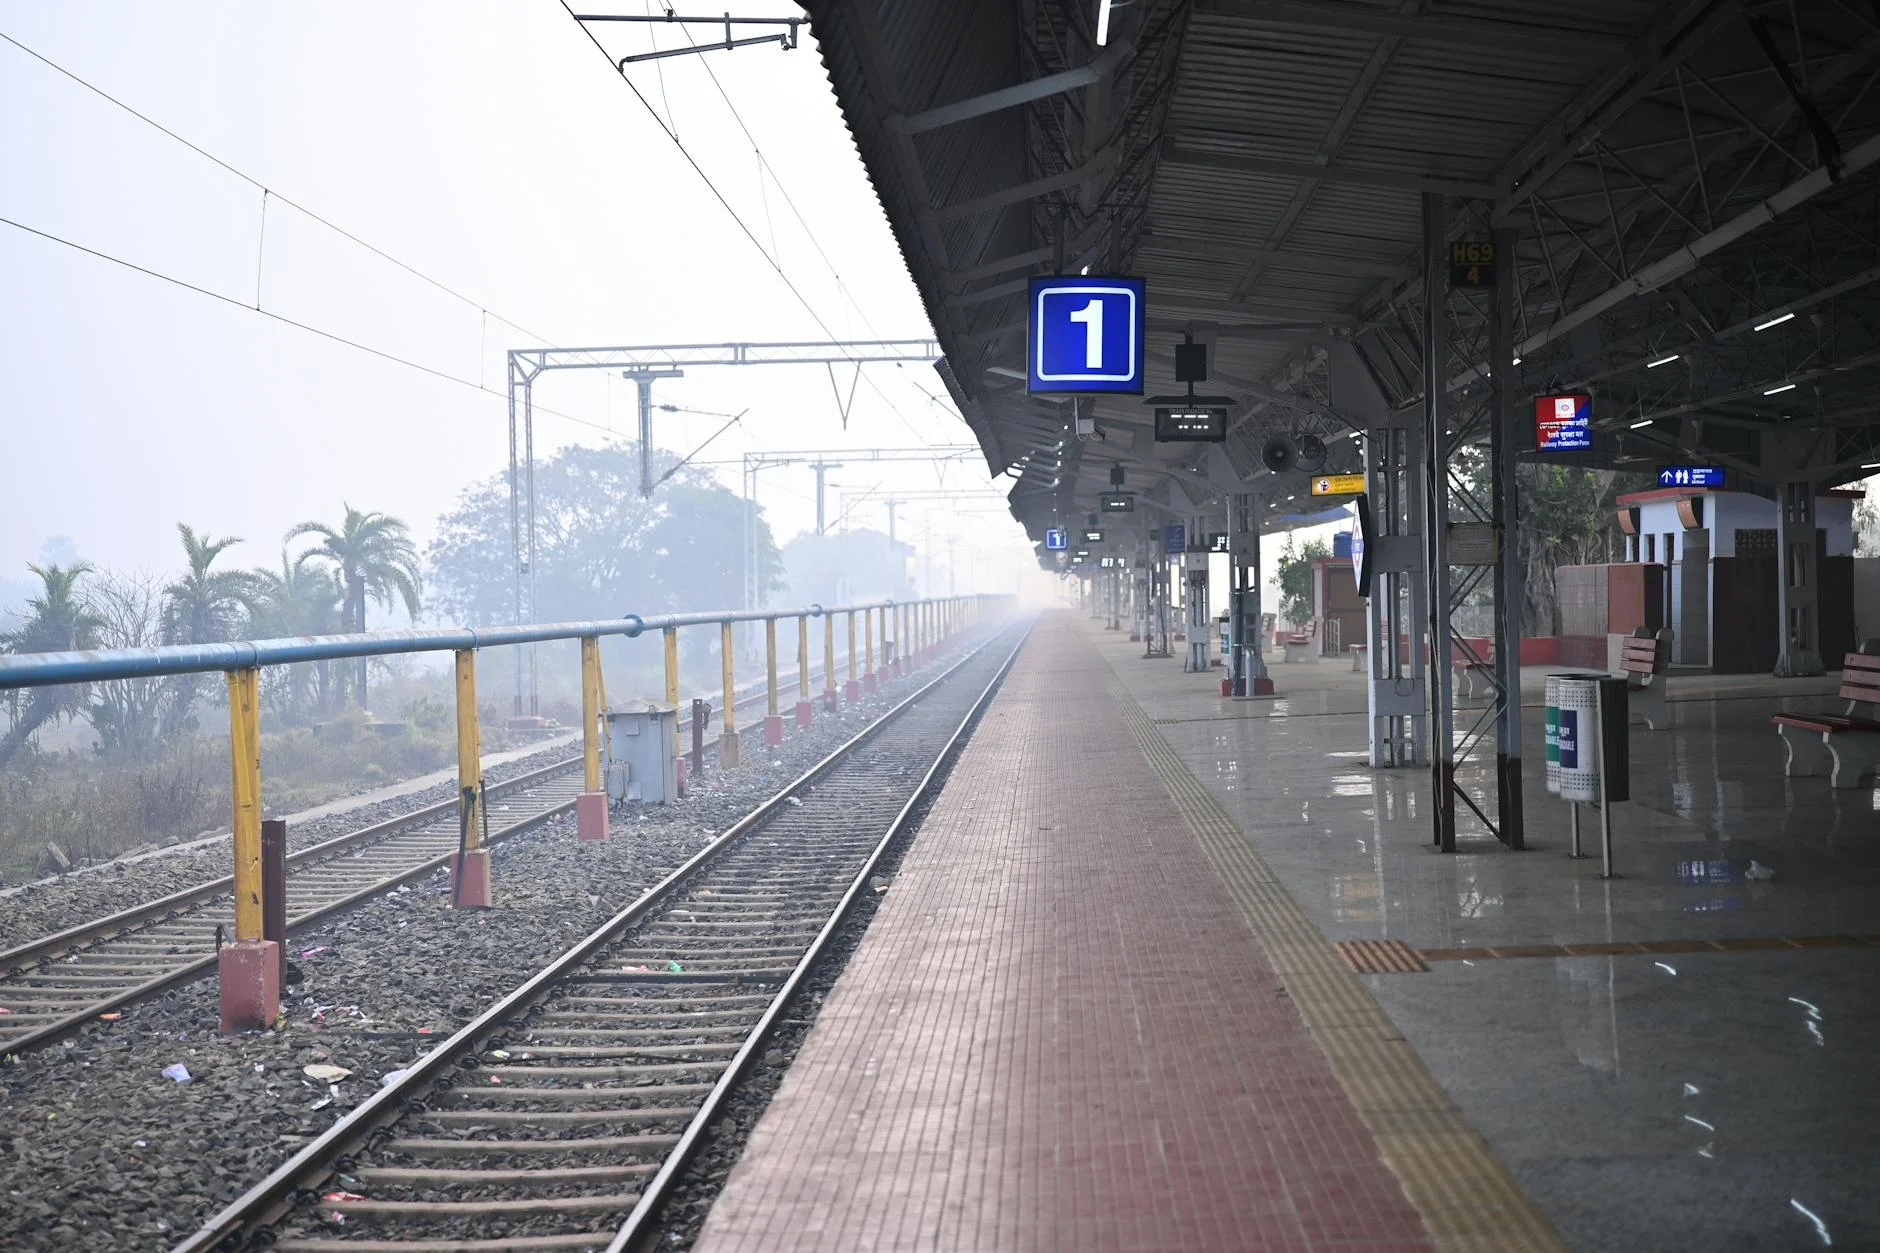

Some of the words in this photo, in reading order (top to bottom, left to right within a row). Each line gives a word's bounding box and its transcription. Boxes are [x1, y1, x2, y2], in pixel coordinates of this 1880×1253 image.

[1454, 243, 1493, 262] H69
[1467, 266, 1479, 285] 4
[1070, 299, 1104, 369] 1
[1540, 441, 1558, 449] Railway
[1052, 533, 1061, 546] 1
